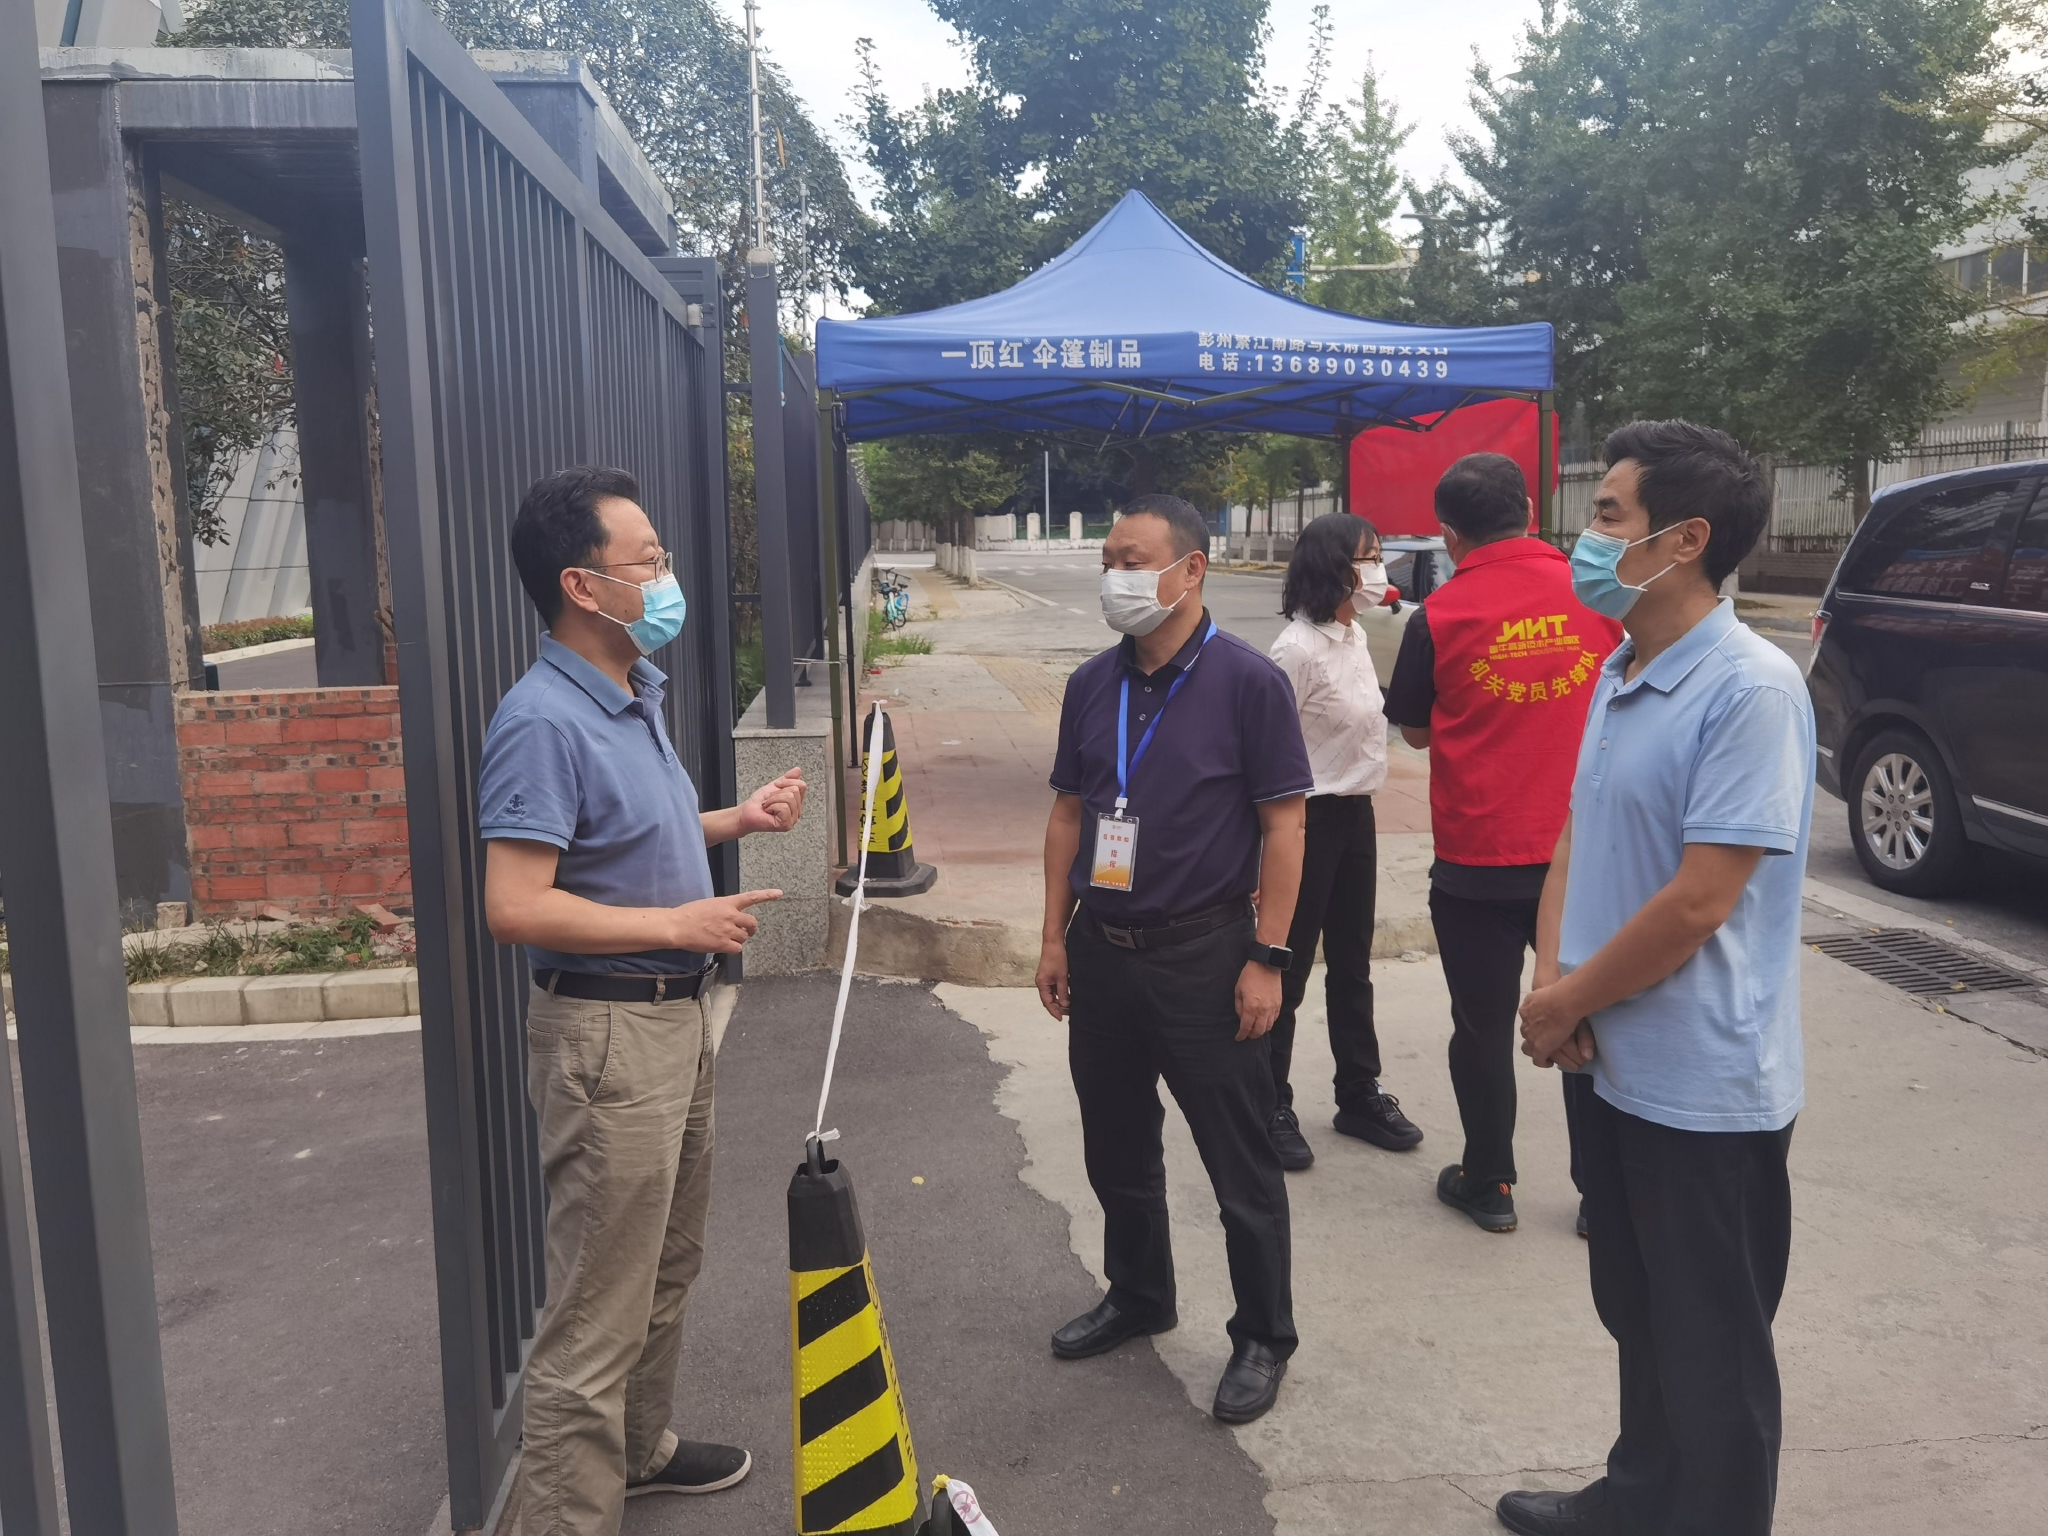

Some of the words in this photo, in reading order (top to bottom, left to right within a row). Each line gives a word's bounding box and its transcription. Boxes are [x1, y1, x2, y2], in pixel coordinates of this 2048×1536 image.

[1469, 650, 1599, 703] 机关党员先锋队
